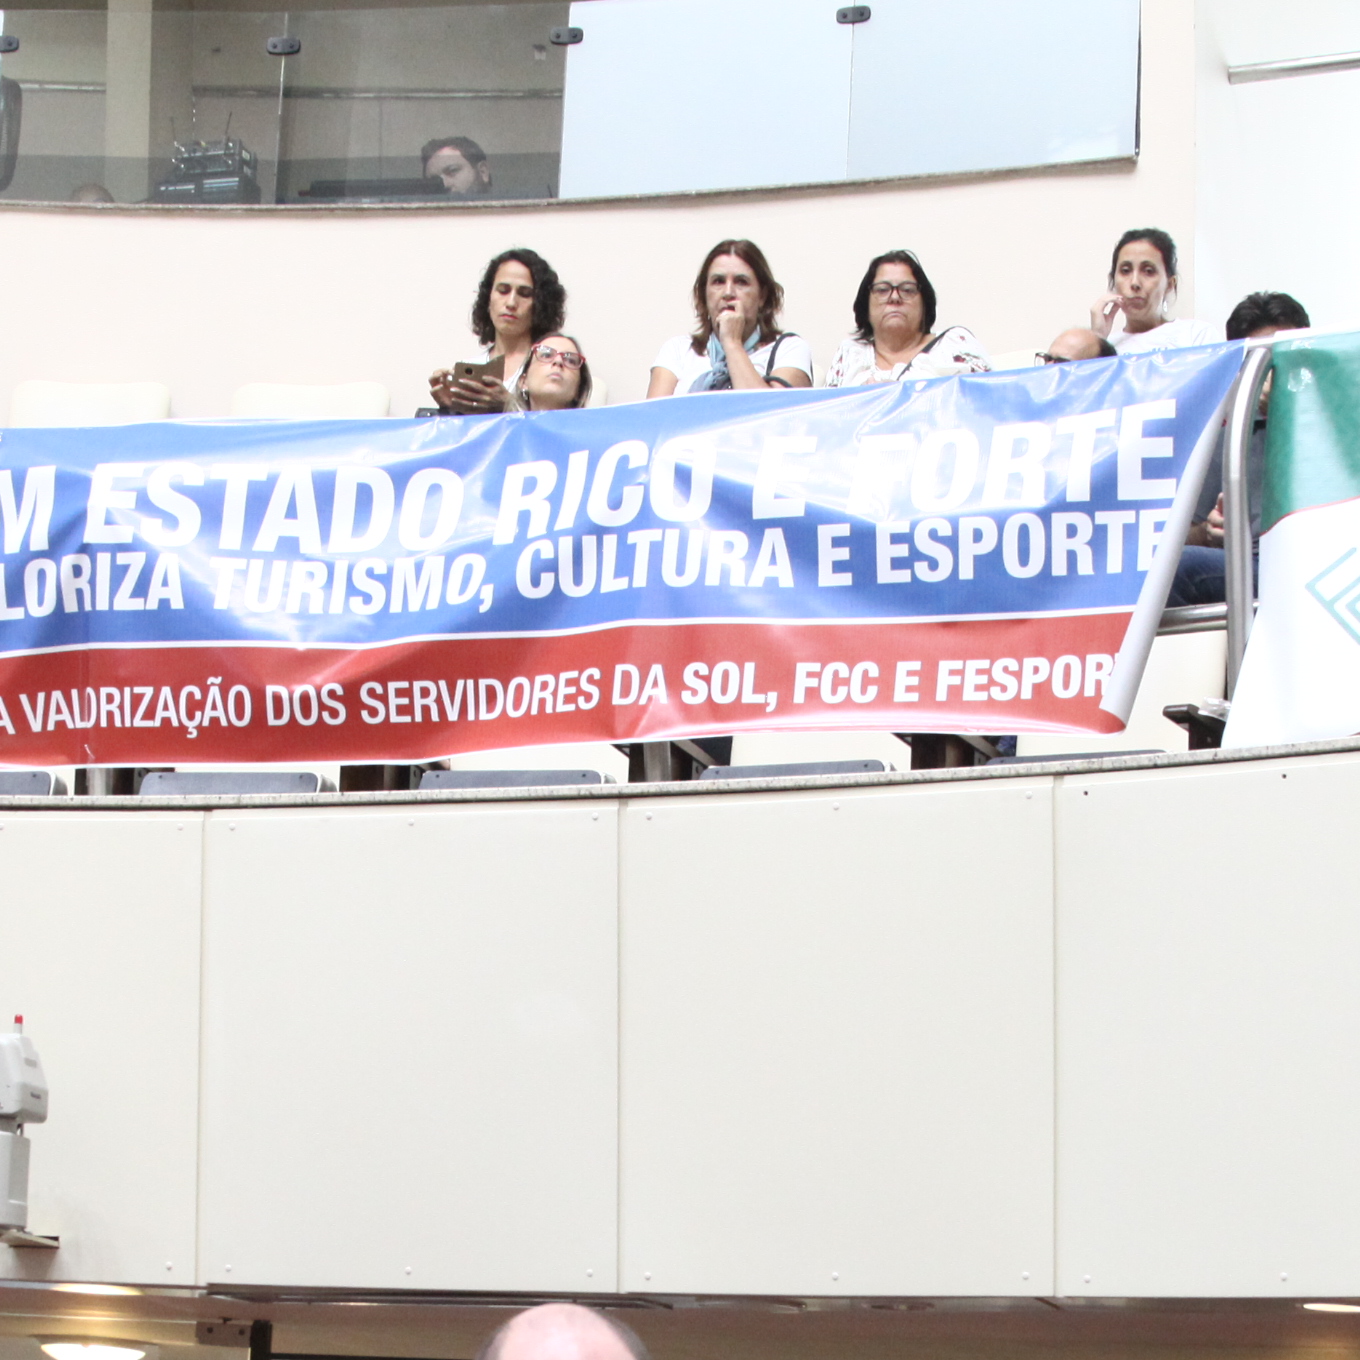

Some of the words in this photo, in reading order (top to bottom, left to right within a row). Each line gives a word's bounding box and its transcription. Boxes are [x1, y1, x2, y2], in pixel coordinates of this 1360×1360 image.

[83, 462, 463, 554] ESTADO
[493, 436, 717, 547] RICO
[751, 436, 818, 521] E
[847, 398, 1177, 512] FORTE
[209, 554, 494, 615] TURISMO,
[515, 523, 795, 600] CULTURA
[816, 524, 853, 588] E
[875, 507, 1171, 586] ESPORTE
[19, 677, 252, 740] VALORIZAÇÃO
[265, 683, 344, 727] DOS
[359, 665, 600, 727] SERVIDORES
[610, 663, 669, 707] DA
[680, 661, 778, 713] SOL,
[793, 660, 878, 706] FCC
[892, 660, 922, 703] E
[935, 653, 1120, 703] FESPOR
